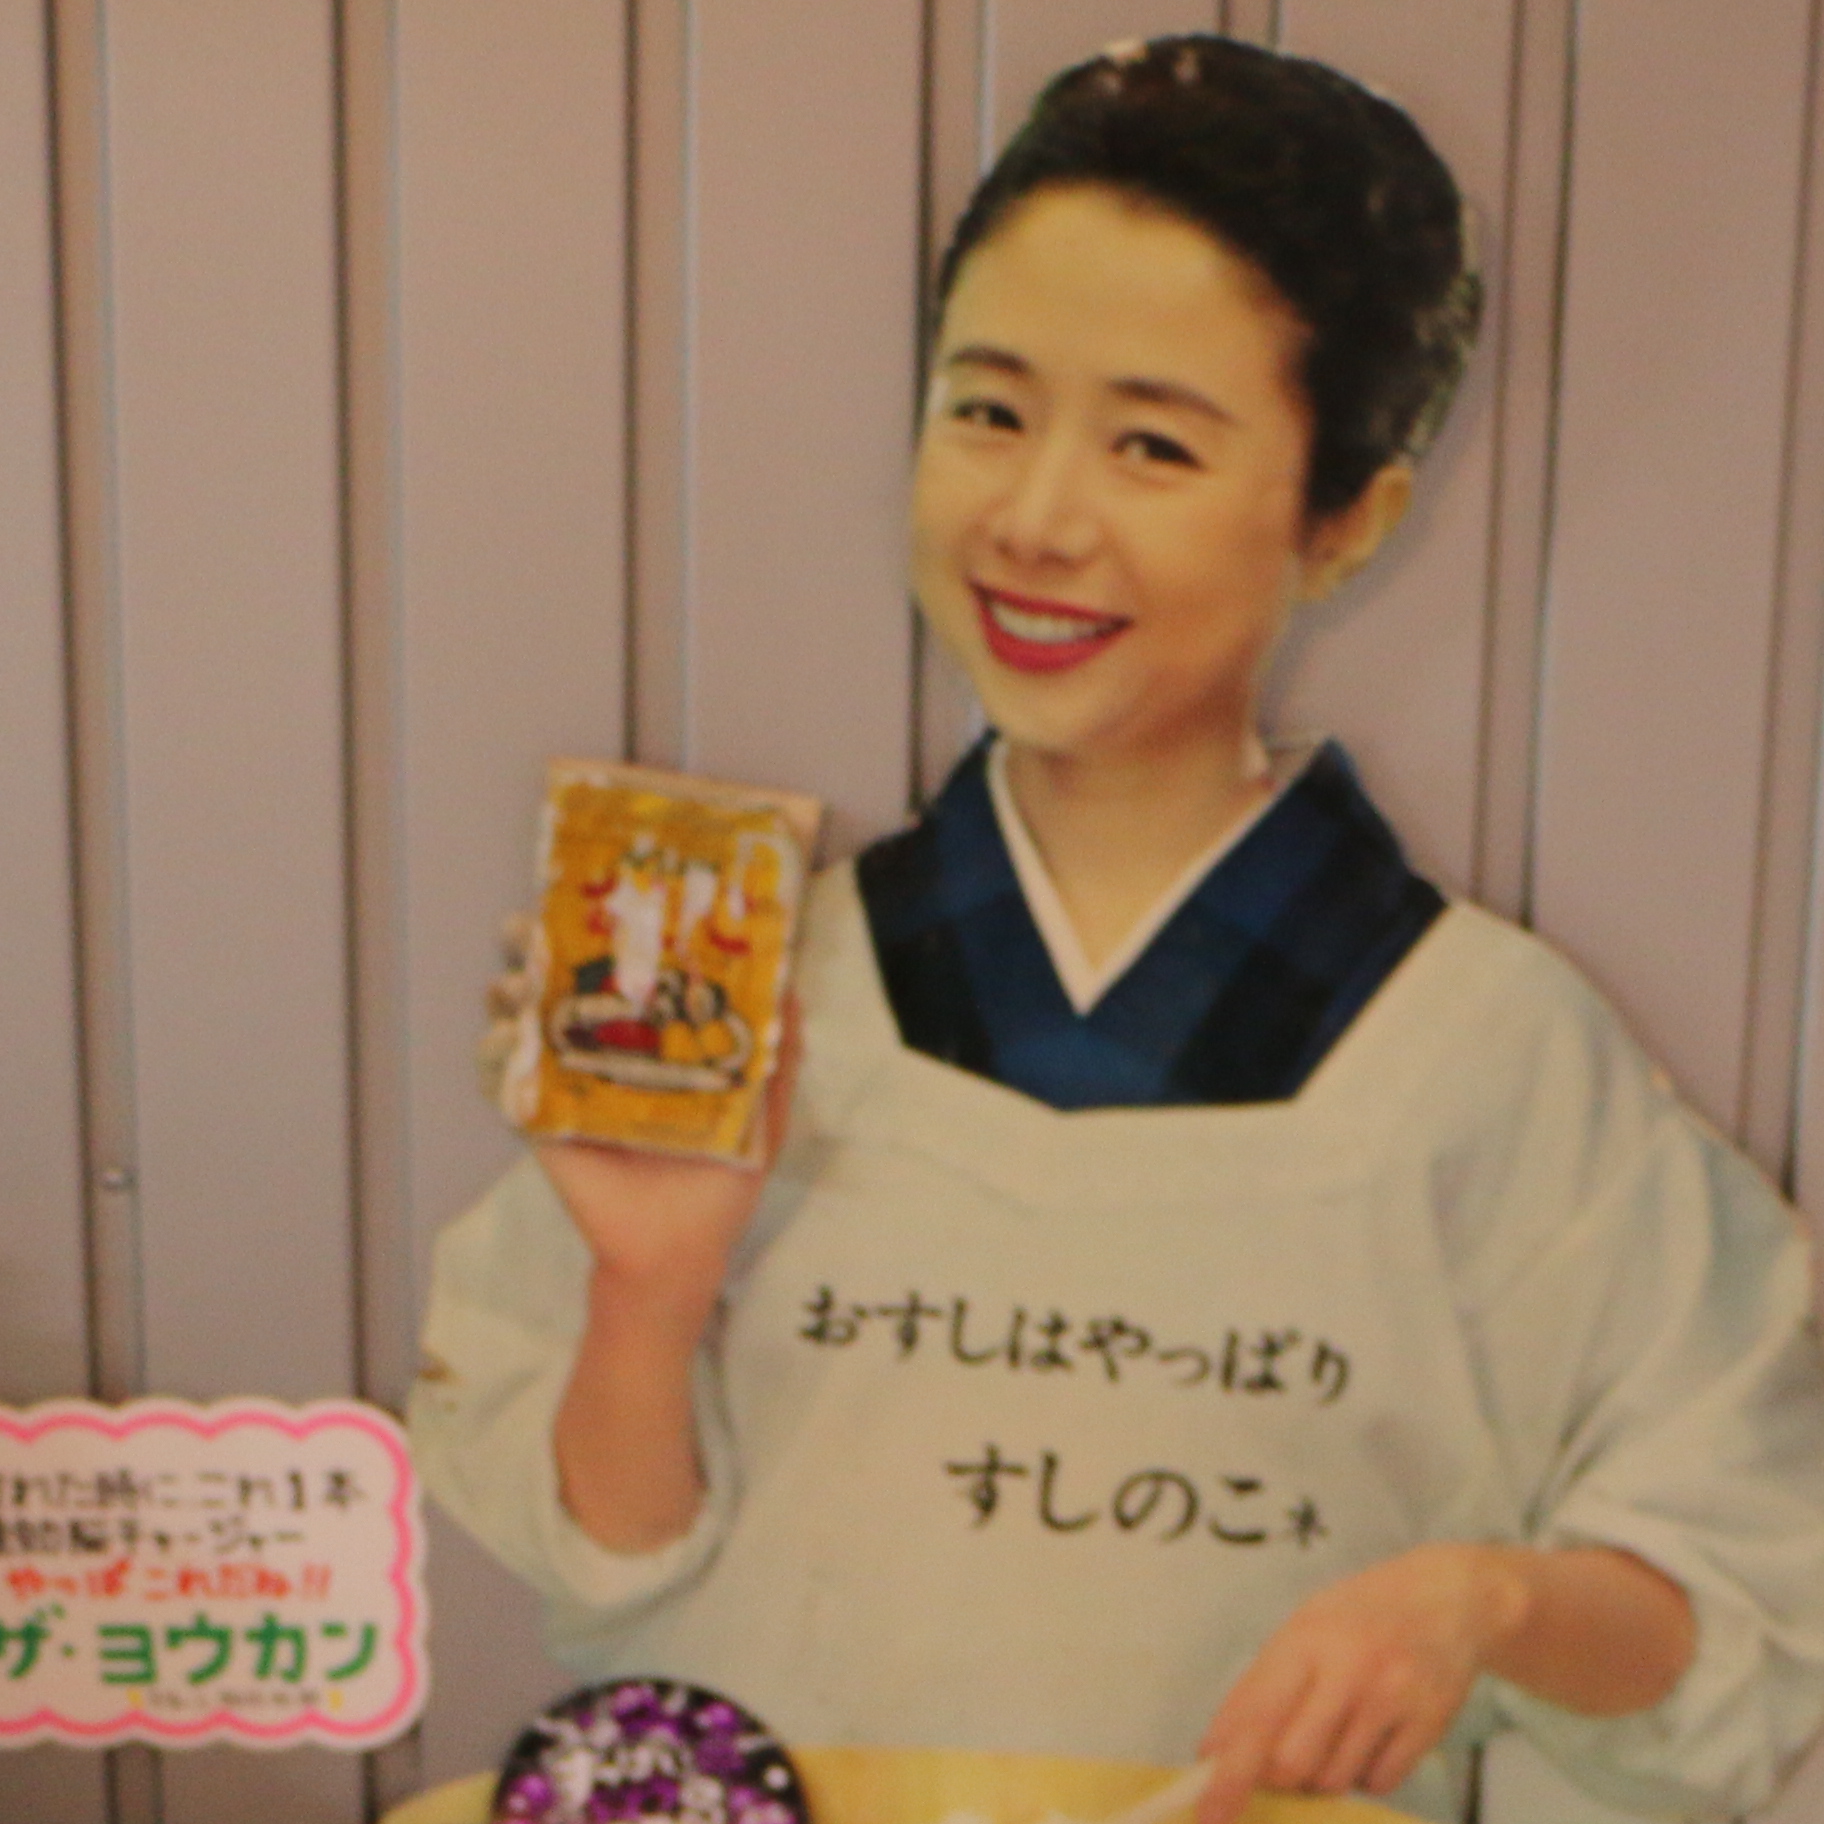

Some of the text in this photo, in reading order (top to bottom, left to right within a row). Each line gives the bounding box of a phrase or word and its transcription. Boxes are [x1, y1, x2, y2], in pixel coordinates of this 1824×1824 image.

[797, 1284, 1352, 1407] おすしはやっぱり
